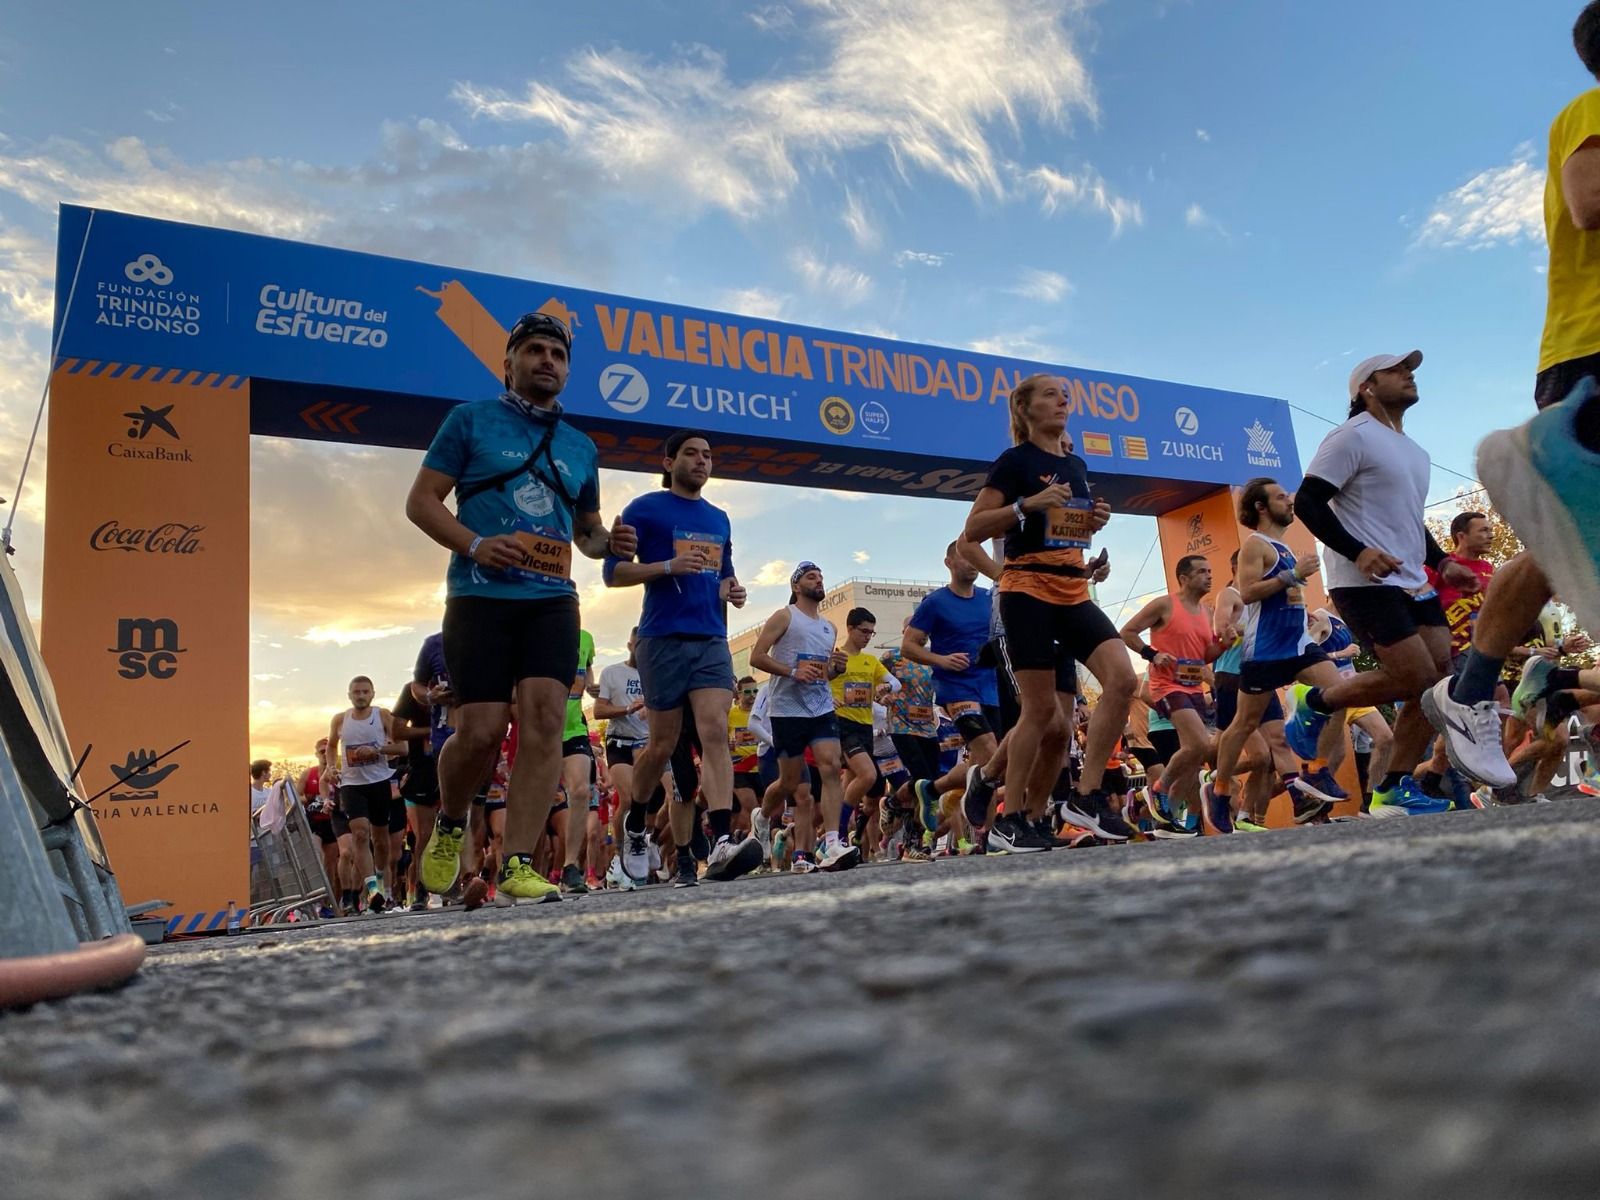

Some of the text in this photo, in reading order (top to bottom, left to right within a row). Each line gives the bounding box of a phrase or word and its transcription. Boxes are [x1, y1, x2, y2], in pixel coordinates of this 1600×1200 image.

[97, 281, 200, 304] FUNDACIÓN
[95, 293, 201, 321] TRINIDAD
[259, 284, 388, 324] Cultura del
[95, 310, 200, 336] ALFONSO
[255, 308, 388, 348] Esfuerzo
[594, 303, 1140, 422] VALENCIA TRINIDAD AONSO
[666, 381, 792, 422] ZURICH
[107, 443, 193, 463] CaixaBank
[1160, 440, 1224, 462] ZURICH
[1247, 453, 1282, 468] luanvi
[89, 520, 206, 554] Coca-Cola
[1186, 534, 1213, 553] AIMS
[533, 541, 563, 559] 4347
[520, 554, 564, 574] Vicente
[864, 585, 905, 598] Campus
[92, 802, 220, 819] RIA VALENCIA
